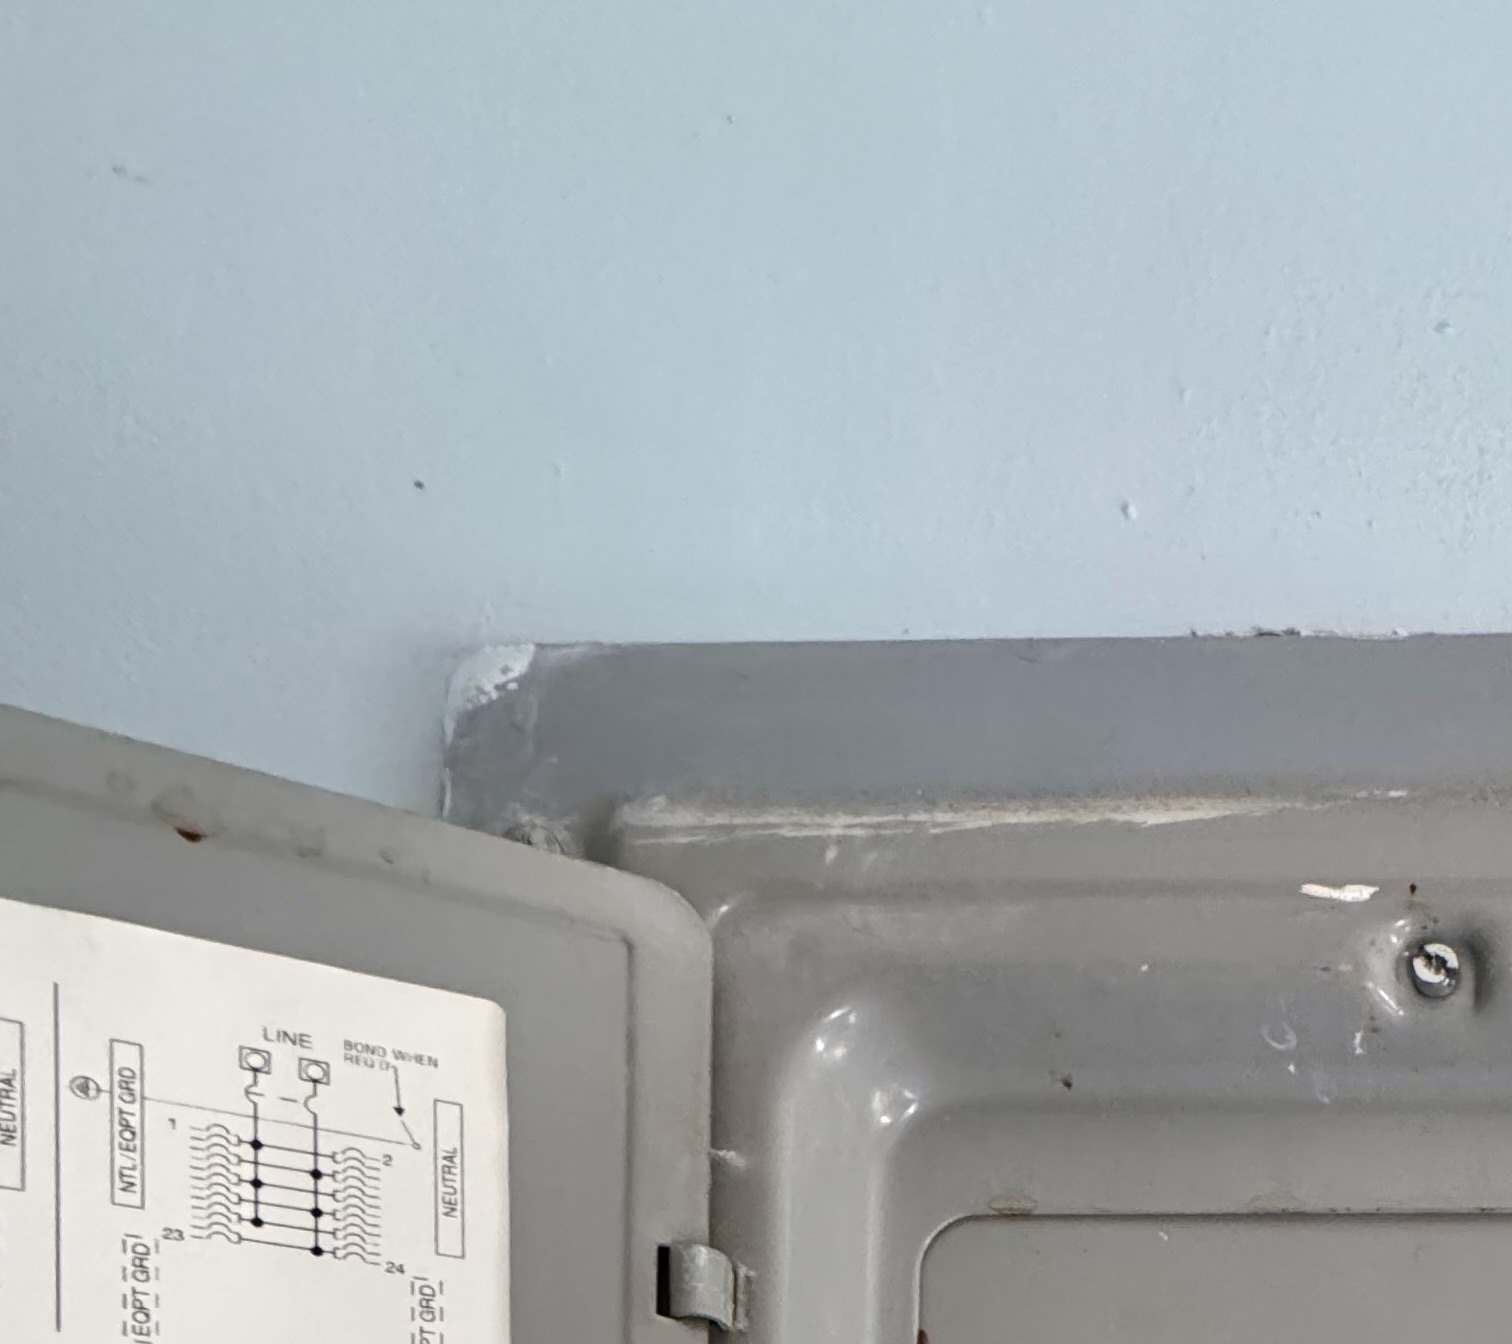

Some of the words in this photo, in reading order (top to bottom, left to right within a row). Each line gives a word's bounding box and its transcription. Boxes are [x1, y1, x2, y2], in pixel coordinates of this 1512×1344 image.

[262, 1026, 313, 1049] LINE
[117, 1067, 136, 1105] GRD
[116, 1107, 137, 1194] NTL/EQPT
[440, 1146, 458, 1218] NEUTRAL
[162, 1227, 184, 1241] 23
[131, 1241, 150, 1283] GRD
[385, 1260, 406, 1275] 24
[133, 1286, 152, 1337] EQPT
[417, 1283, 436, 1322] GRD
